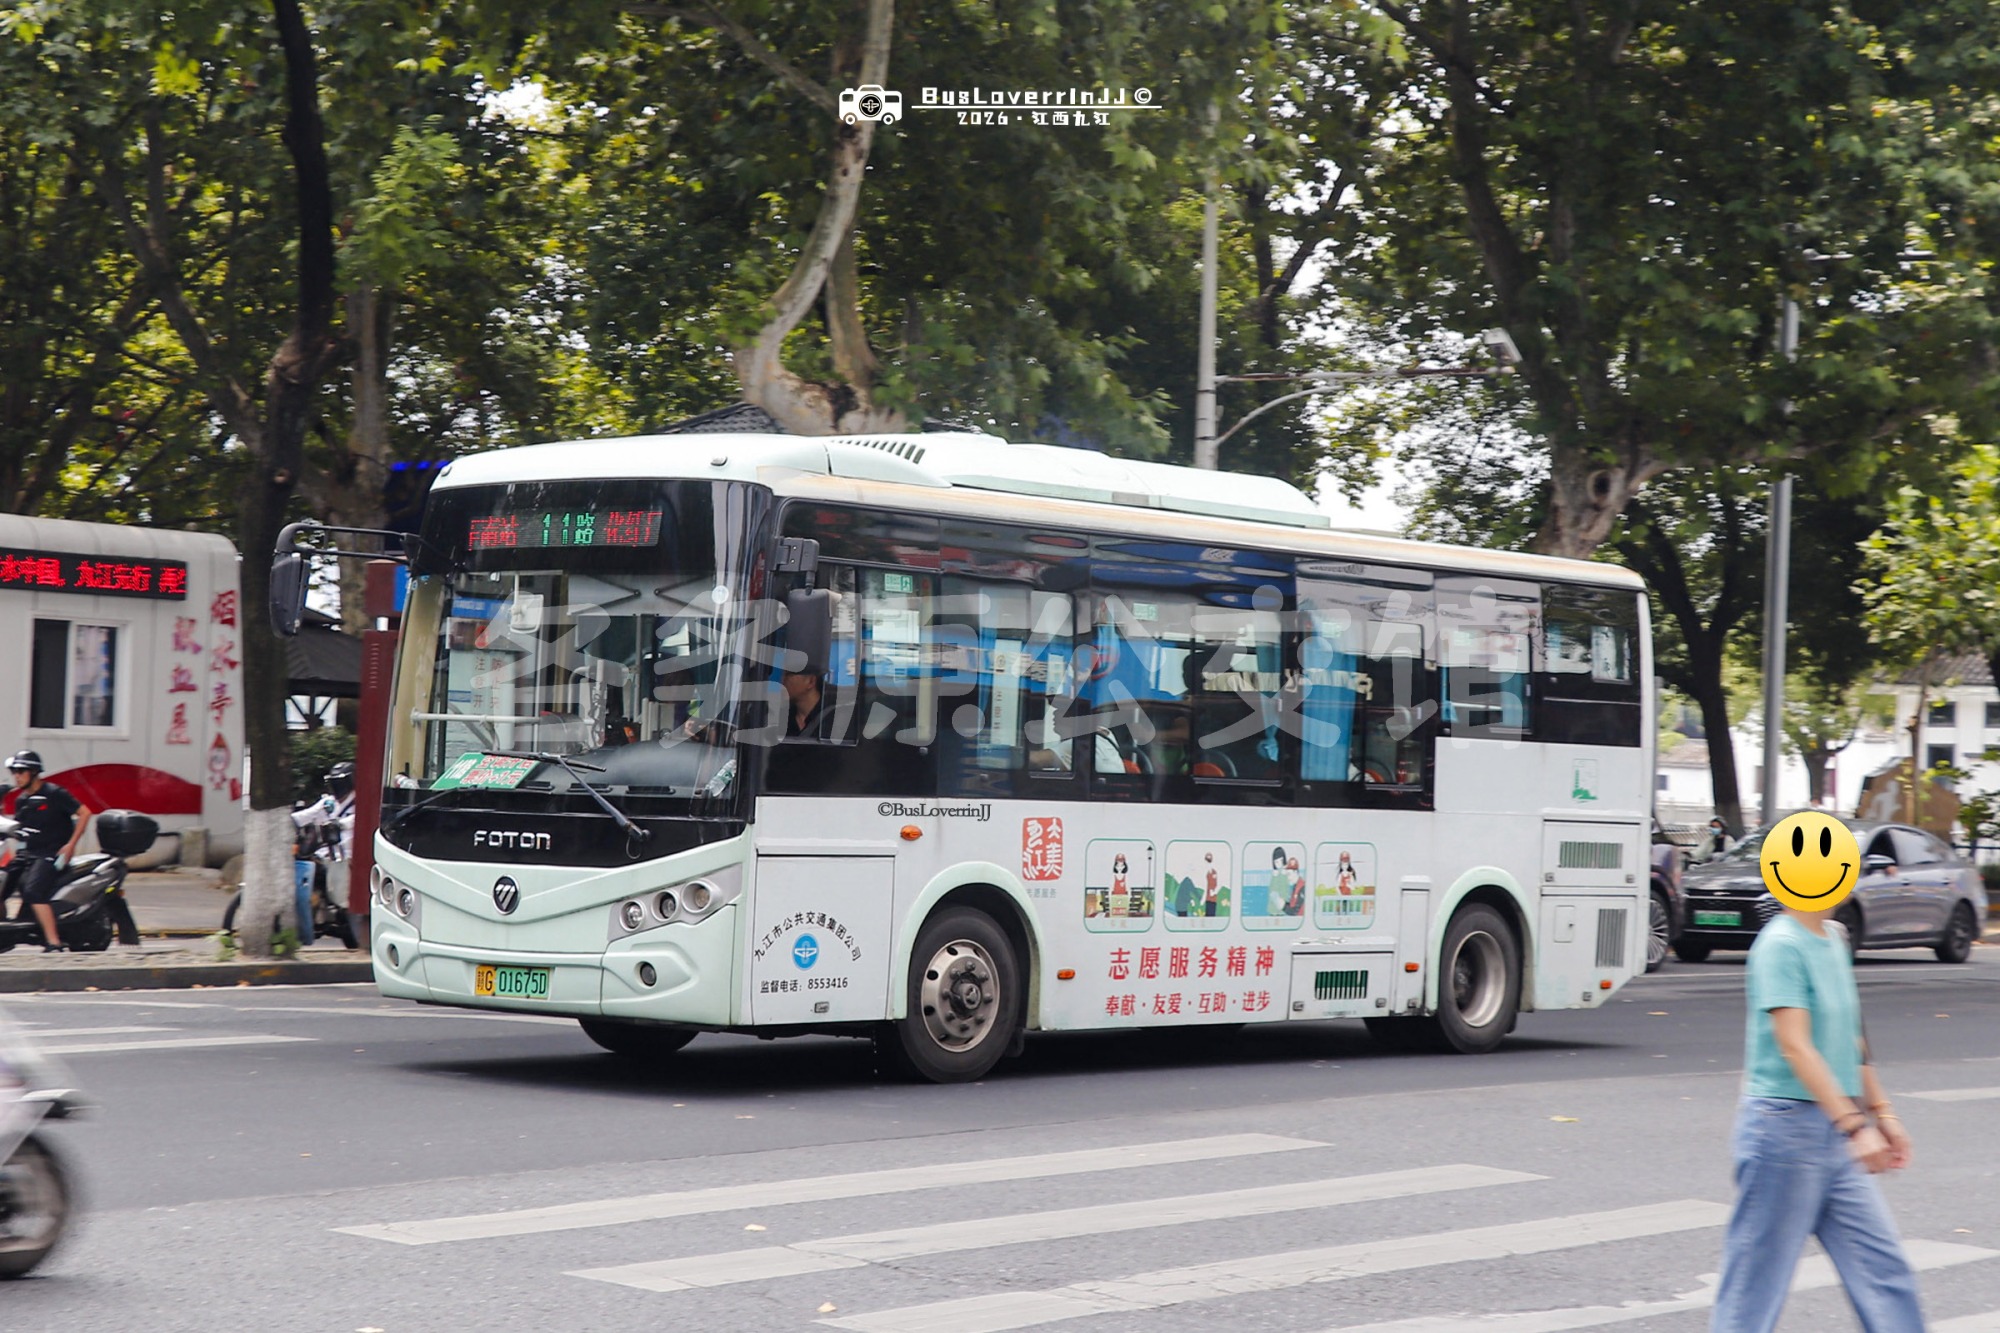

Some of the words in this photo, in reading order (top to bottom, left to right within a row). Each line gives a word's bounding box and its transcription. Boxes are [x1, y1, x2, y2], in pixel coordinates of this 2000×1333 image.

[473, 830, 551, 850] FOTON
[754, 911, 861, 962] 九江市公共交通集团公司
[1108, 945, 1275, 980] 志愿服务精神
[807, 977, 849, 989] 8553416
